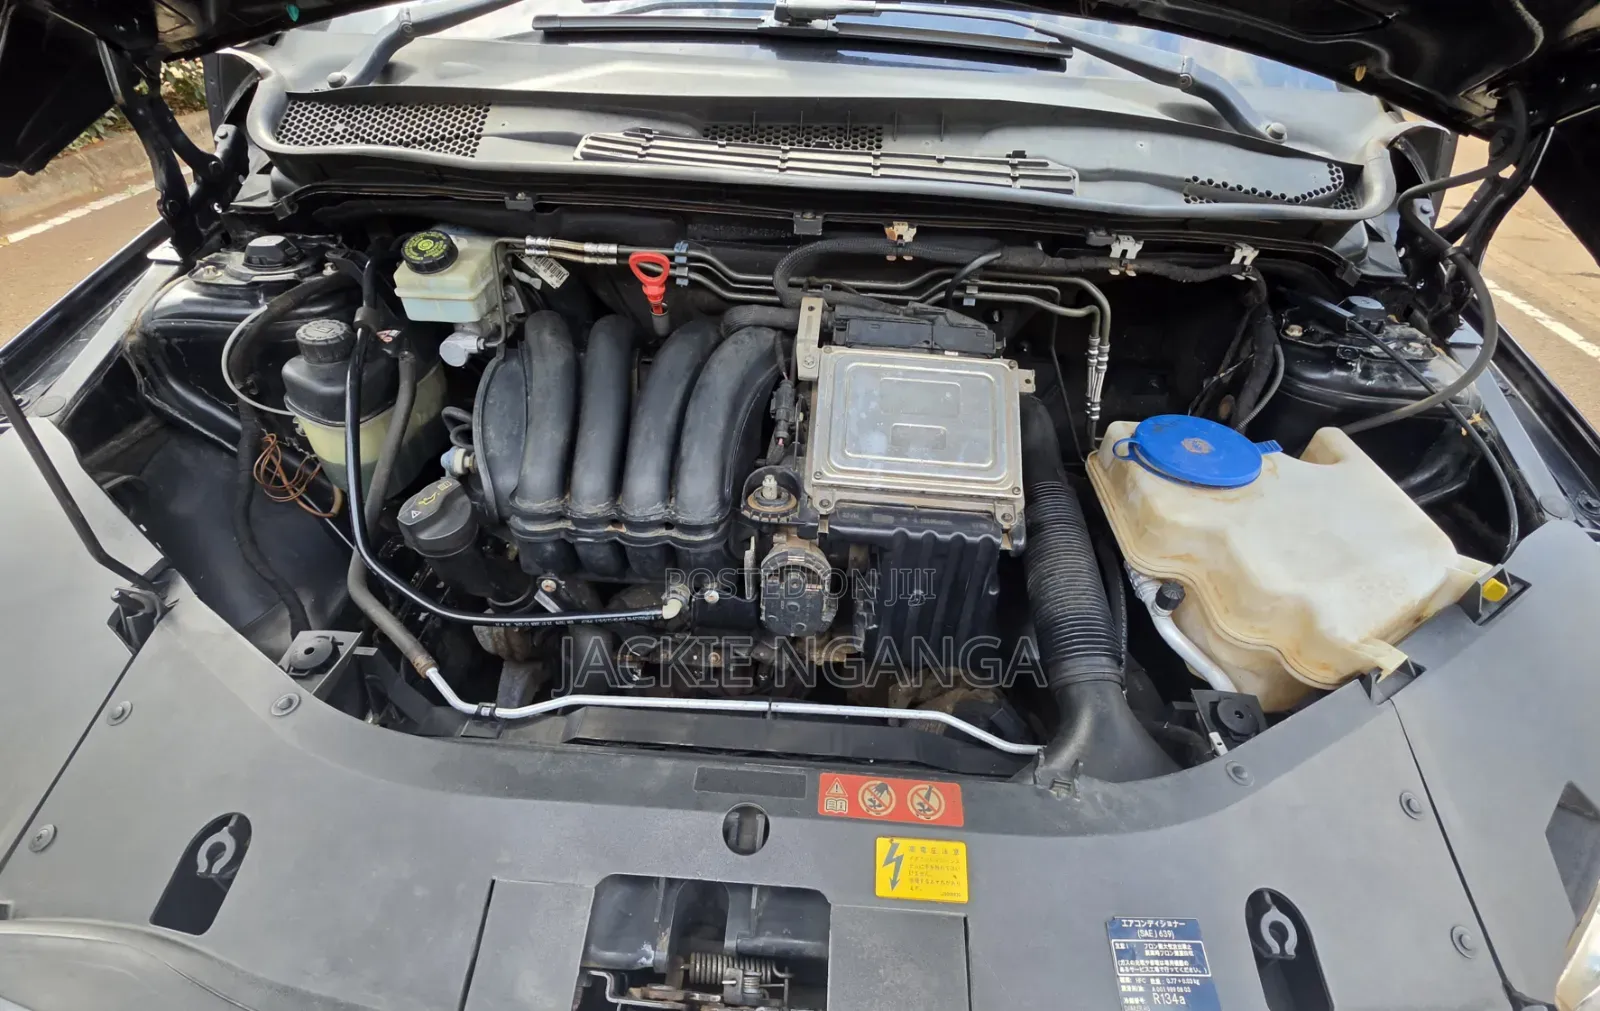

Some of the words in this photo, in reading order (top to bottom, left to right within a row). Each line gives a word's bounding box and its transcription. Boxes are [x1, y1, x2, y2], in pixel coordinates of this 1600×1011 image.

[1121, 919, 1186, 928] エアコンディショナー
[1152, 992, 1187, 1005] R134a
